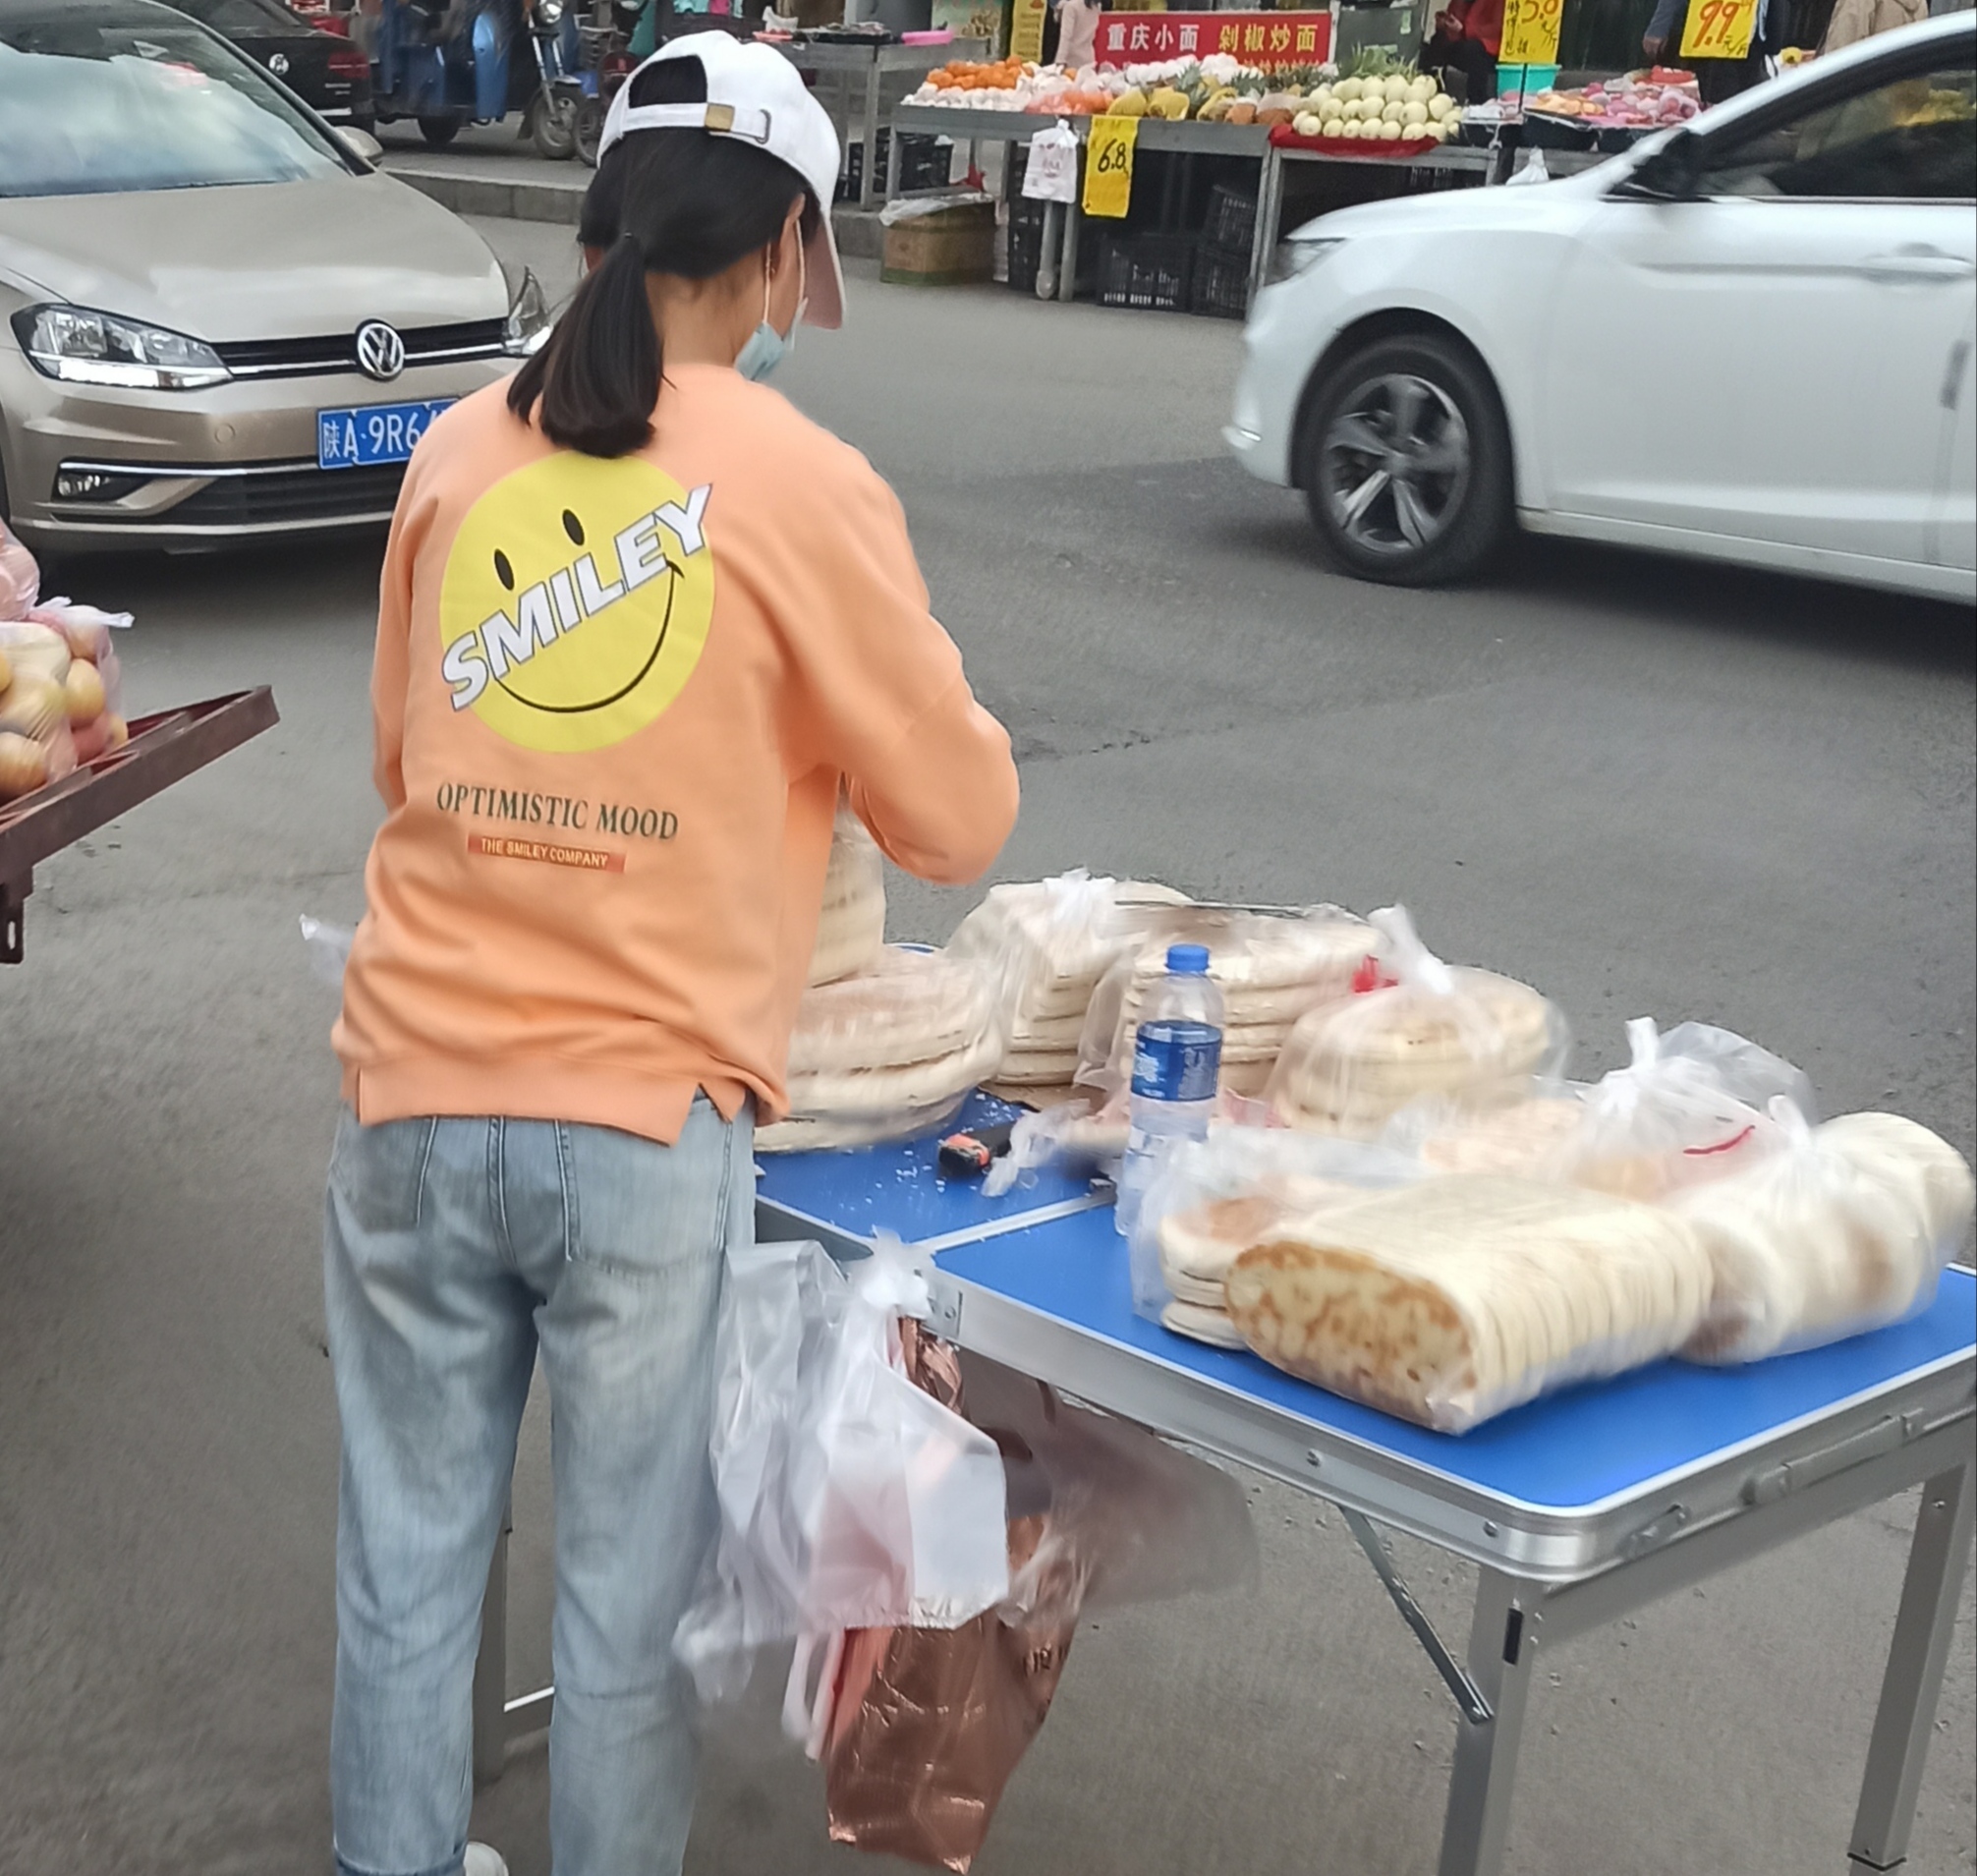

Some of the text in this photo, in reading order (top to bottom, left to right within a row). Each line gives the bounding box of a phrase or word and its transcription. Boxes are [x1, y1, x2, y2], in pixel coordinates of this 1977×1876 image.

[1107, 23, 1318, 52] 重庆小面 剁椒炒面
[1692, 0, 1739, 48] 9.9
[1098, 138, 1126, 173] 6.8
[322, 409, 448, 459] 陕A·9R6
[441, 483, 712, 712] SMILEY
[436, 782, 679, 840] OPTIMISTIC MOOD
[481, 836, 610, 870] THE SMILEY COMPANY
